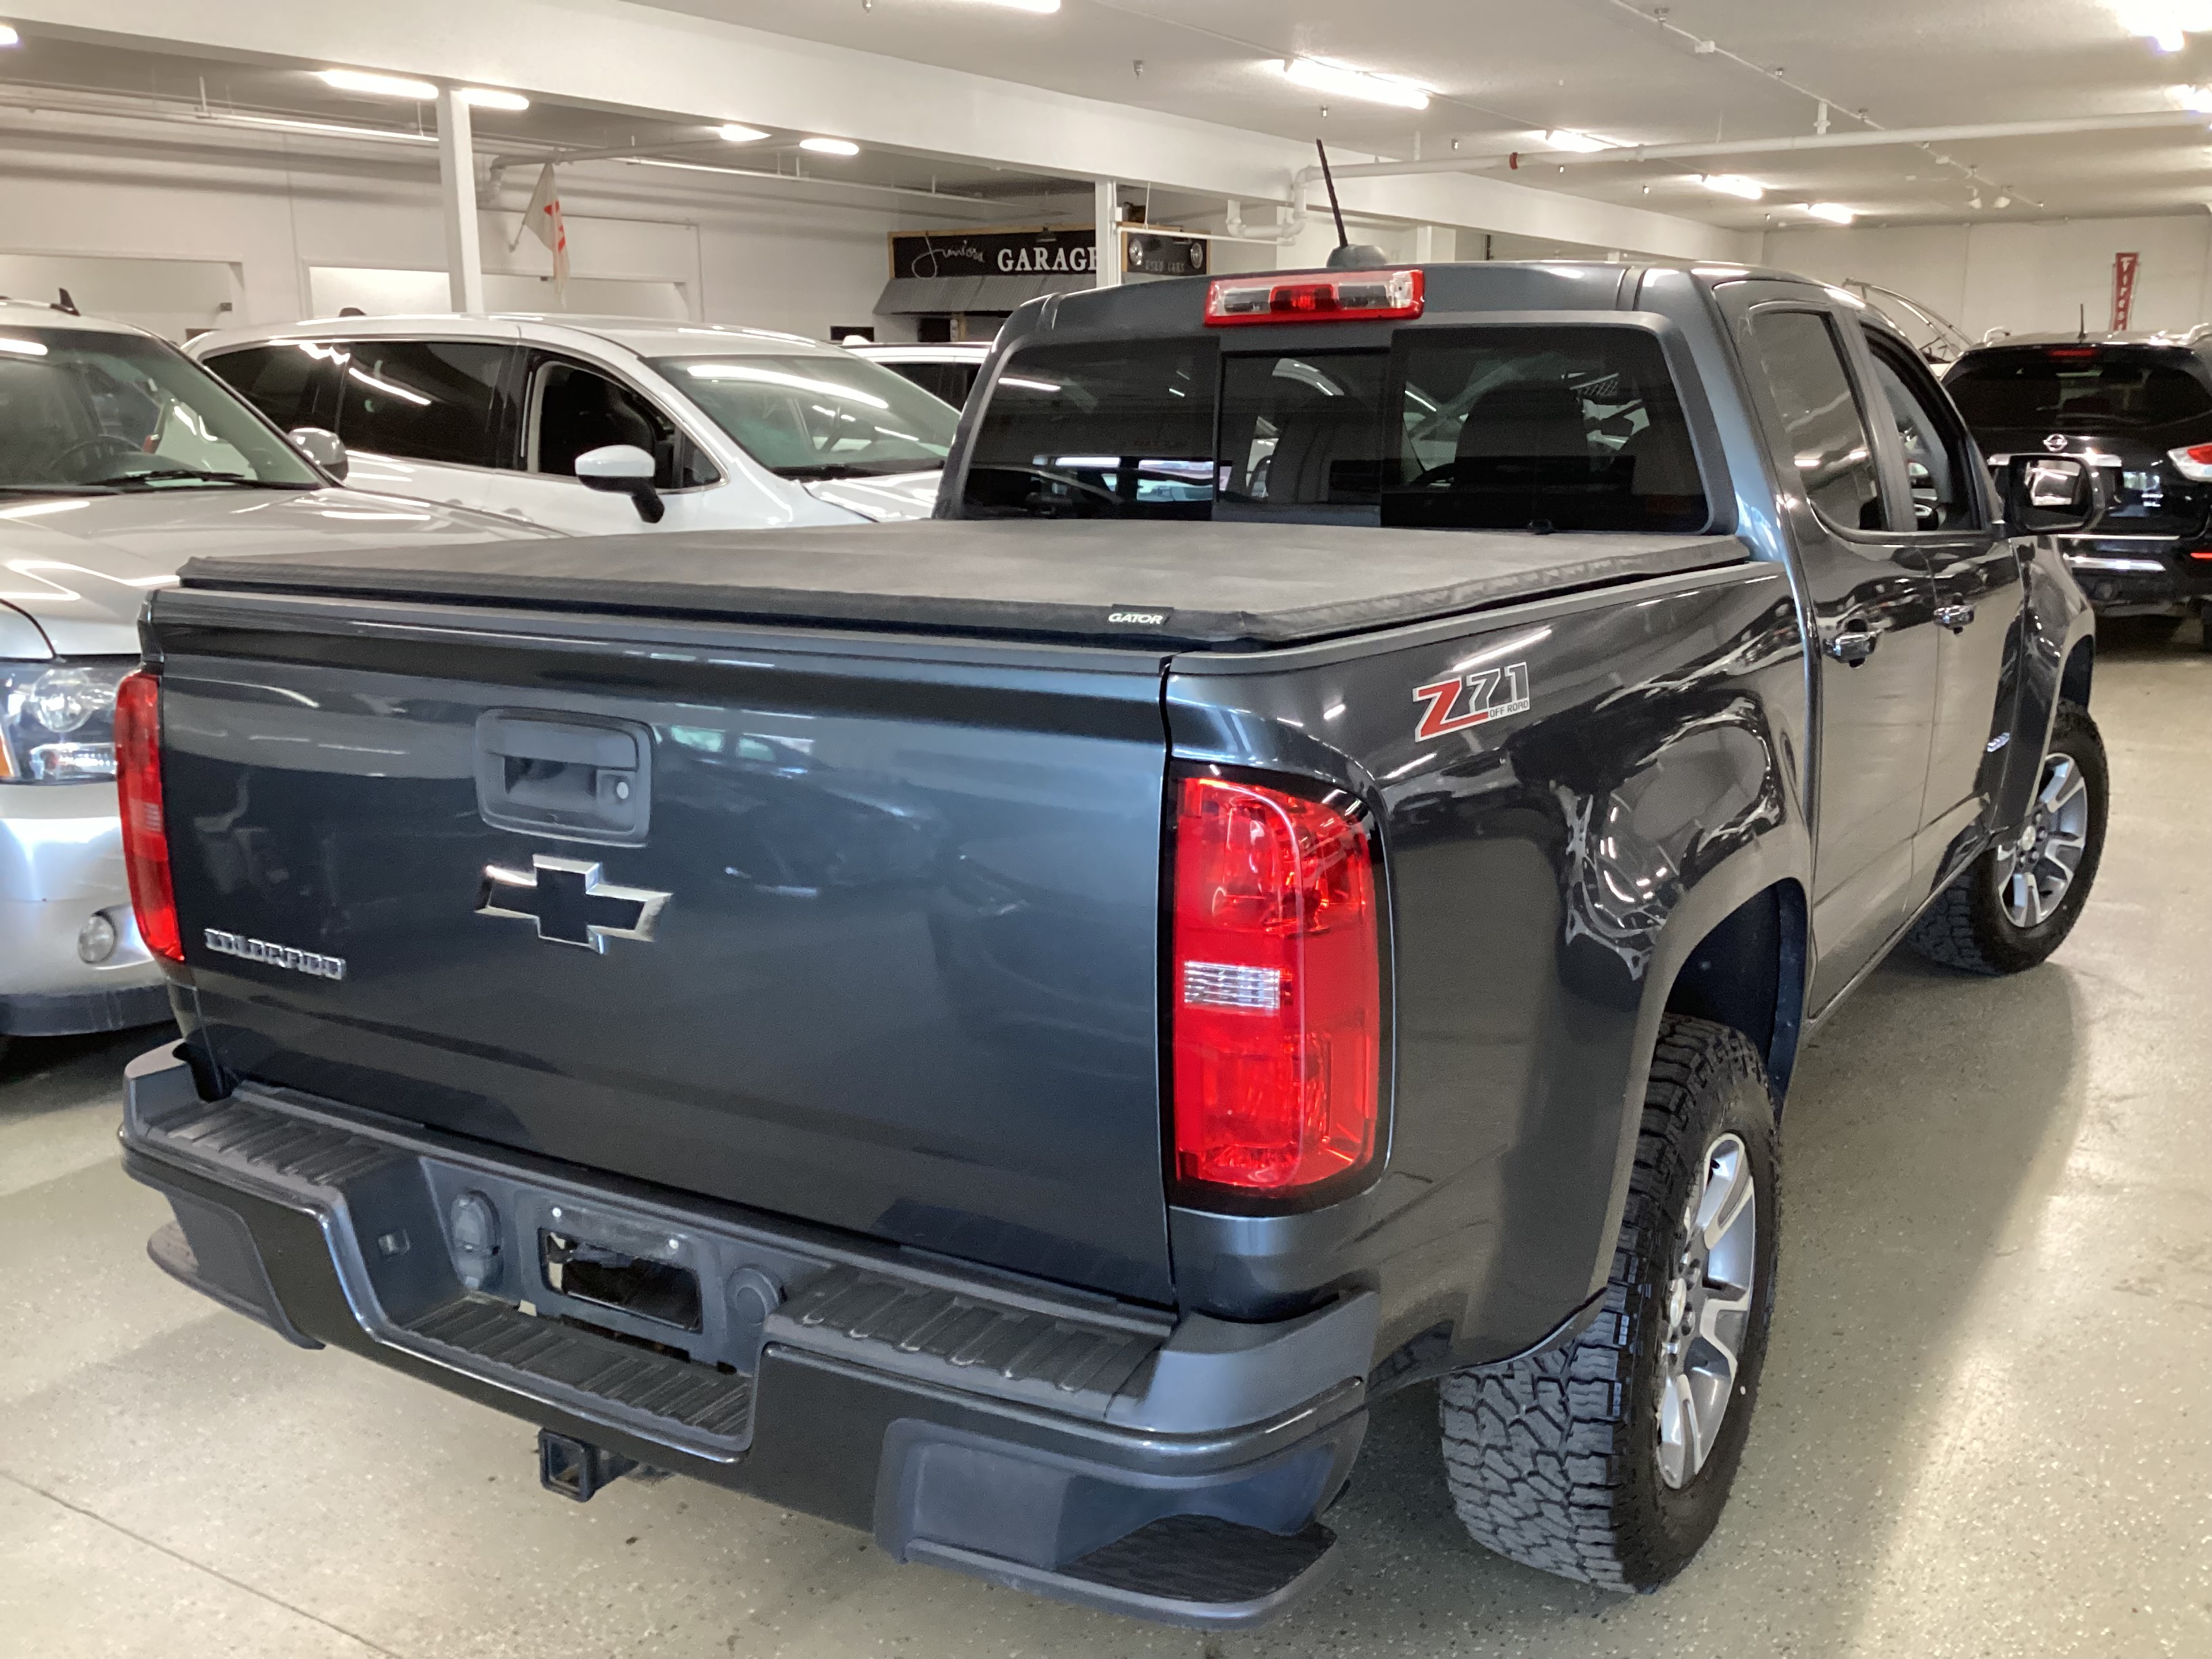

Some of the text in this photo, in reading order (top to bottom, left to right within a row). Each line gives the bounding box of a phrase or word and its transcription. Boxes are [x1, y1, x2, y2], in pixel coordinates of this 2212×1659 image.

[1108, 613, 1164, 625] GATOR
[1412, 661, 1530, 743] Z71
[1489, 700, 1529, 718] OFF ROAD
